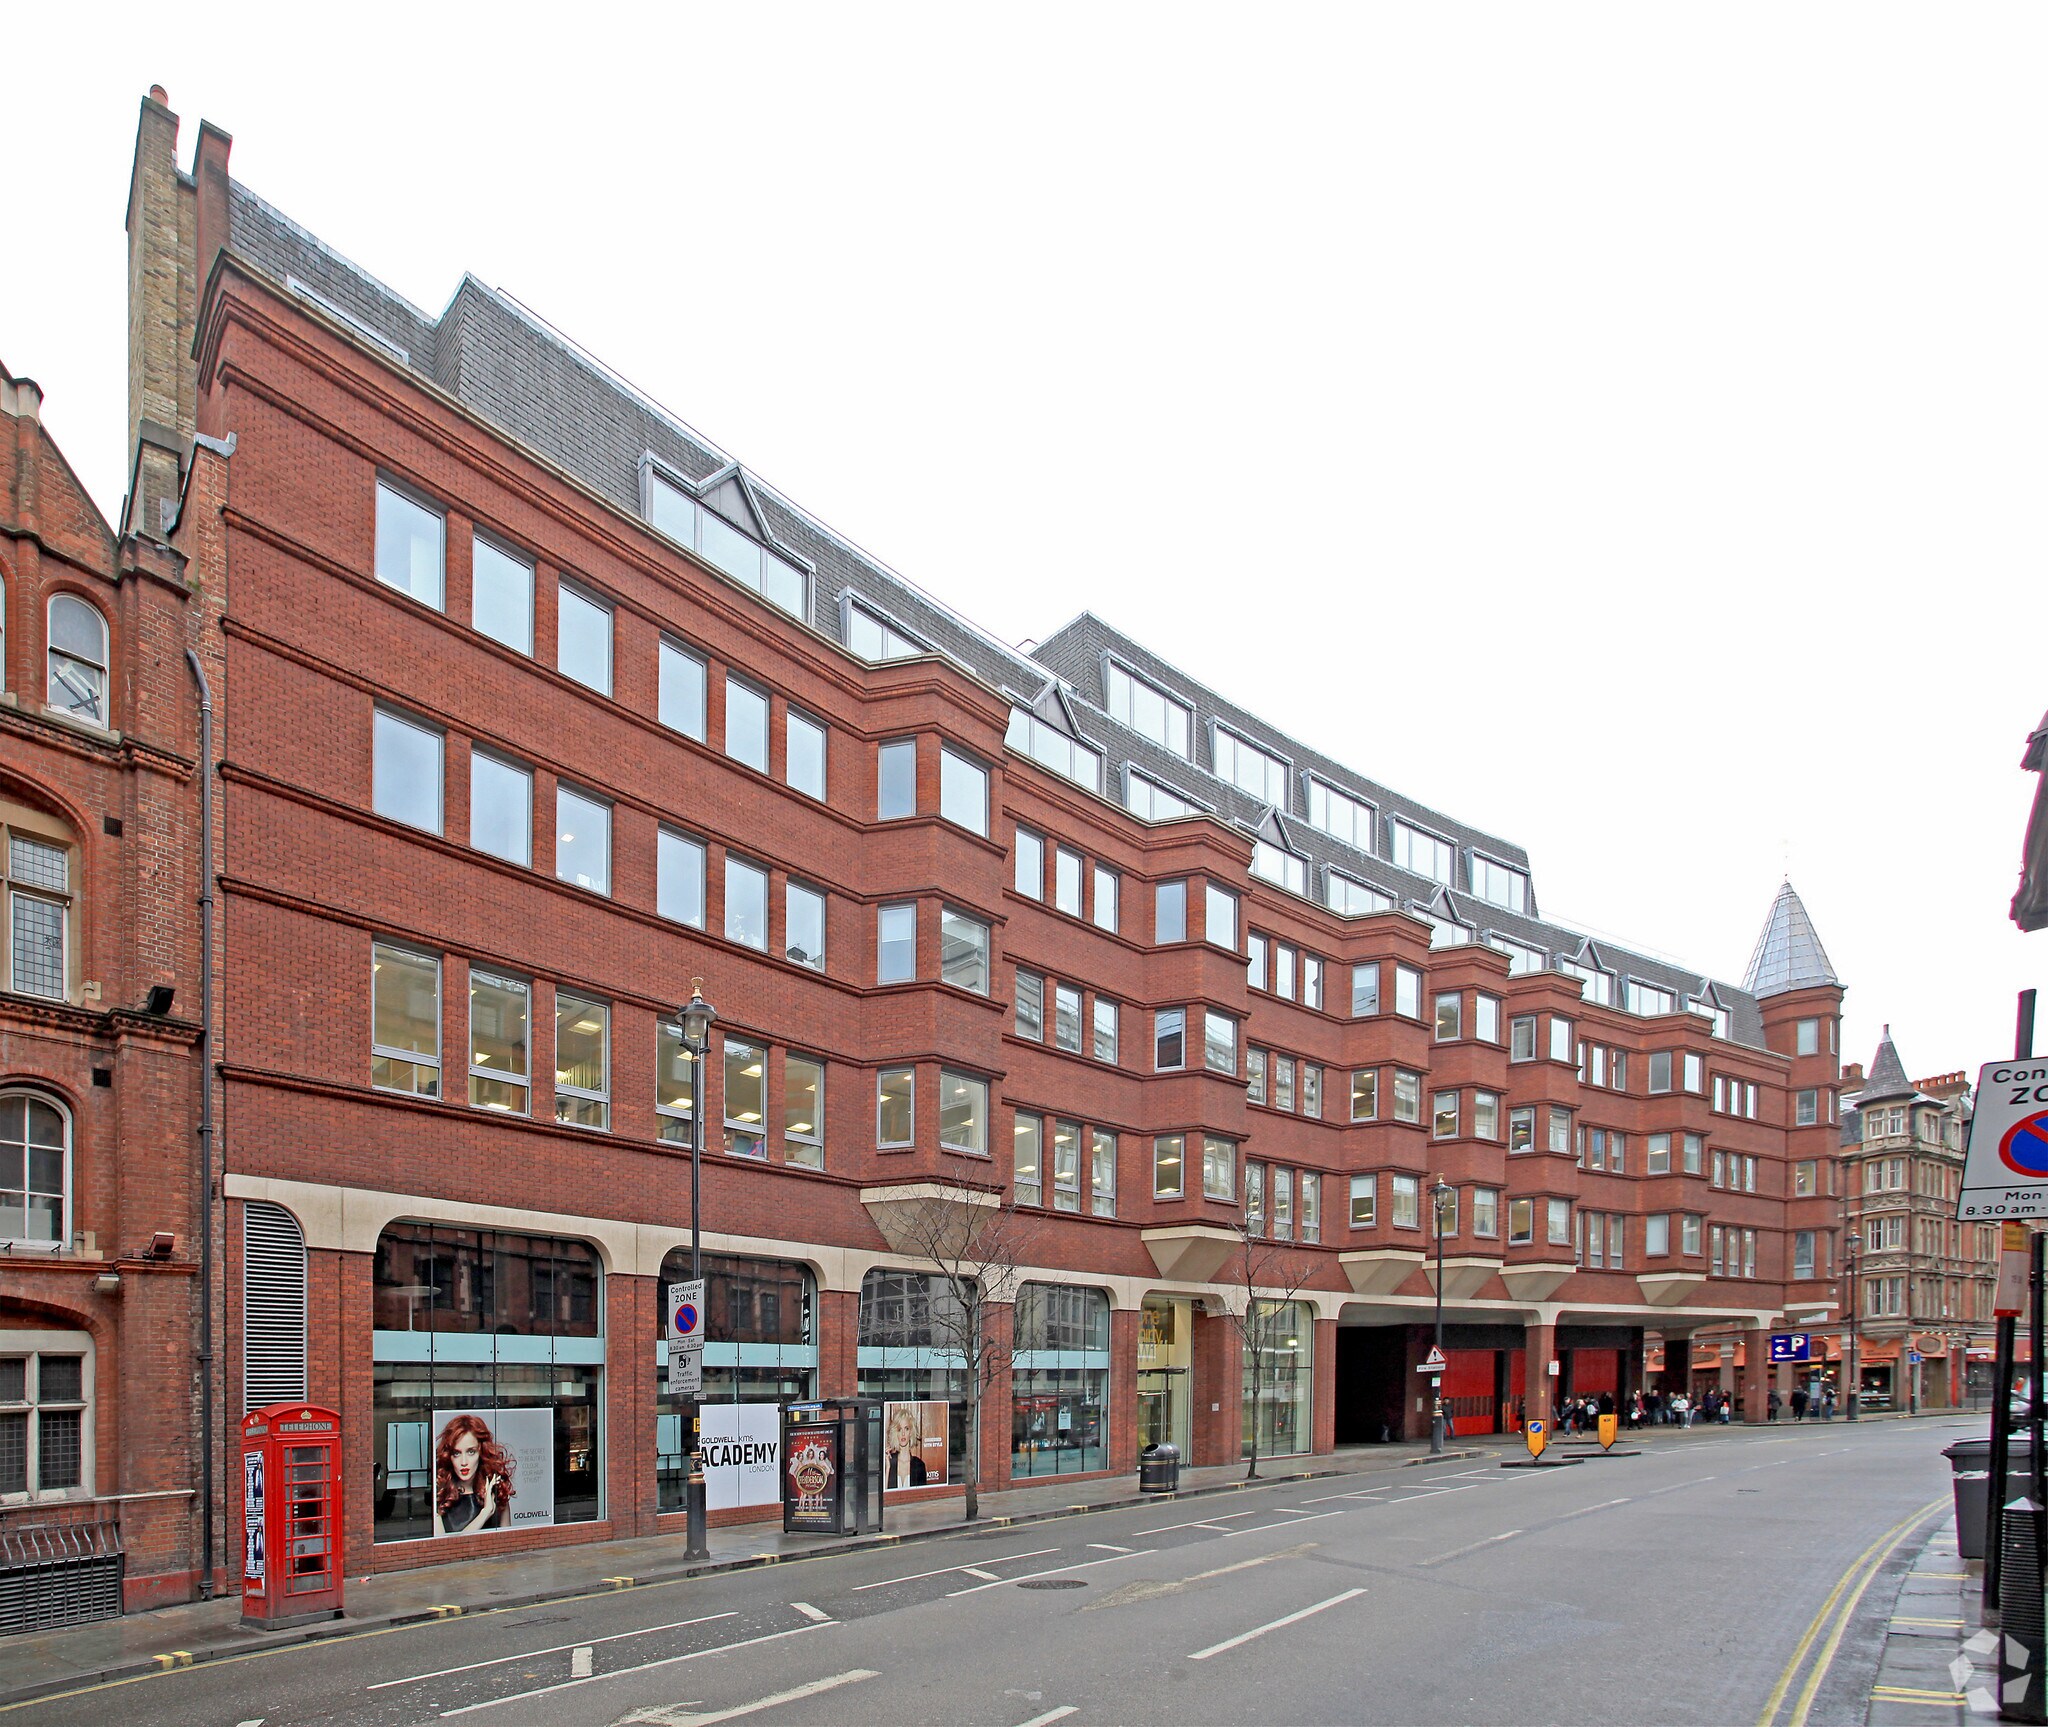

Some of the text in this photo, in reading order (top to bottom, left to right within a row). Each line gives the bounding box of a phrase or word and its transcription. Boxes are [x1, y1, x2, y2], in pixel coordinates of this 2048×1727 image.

[2005, 1191, 2042, 1201] Mon
[1965, 1204, 2006, 1216] 8.30
[2010, 1205, 2036, 1214] am
[670, 1282, 702, 1294] Controlled
[675, 1292, 697, 1303] ZONE
[670, 1377, 700, 1385] enforcement
[282, 1422, 330, 1431] TELEPHONE
[701, 1436, 735, 1444] GOLDWELL
[700, 1443, 778, 1467] ACADEMY
[748, 1465, 775, 1473] LONDON
[513, 1510, 549, 1519] GOLDWELL
